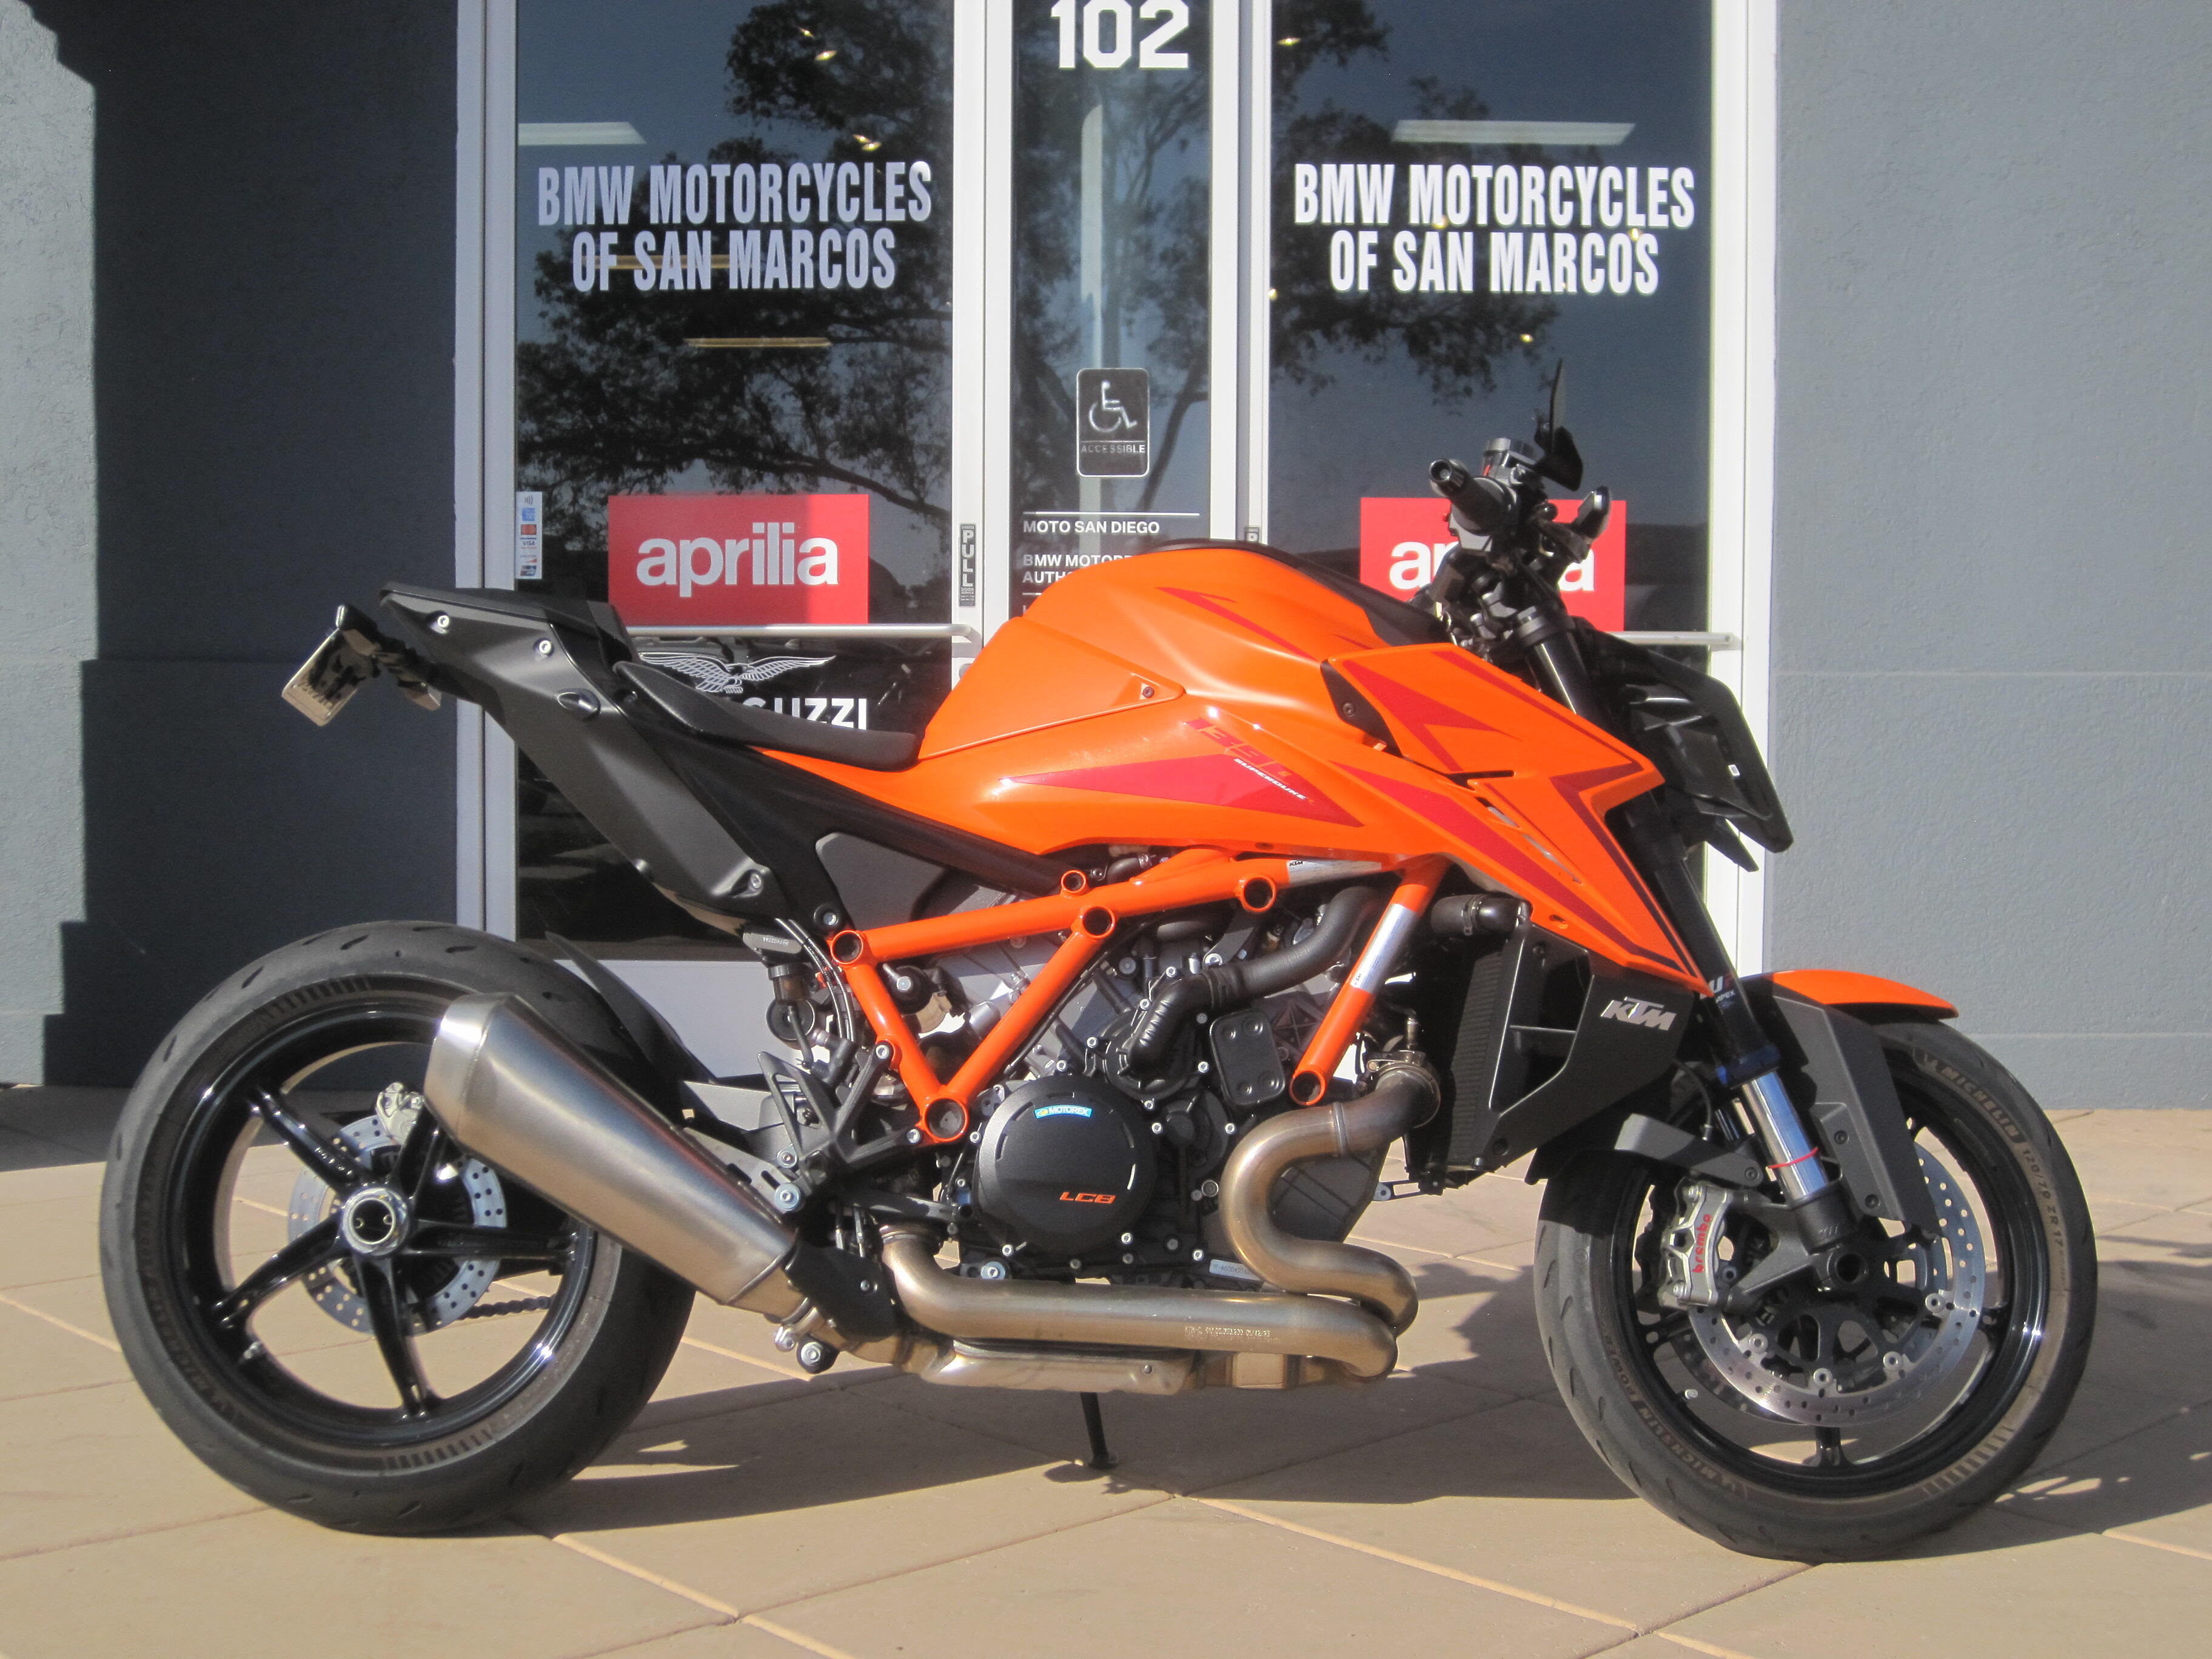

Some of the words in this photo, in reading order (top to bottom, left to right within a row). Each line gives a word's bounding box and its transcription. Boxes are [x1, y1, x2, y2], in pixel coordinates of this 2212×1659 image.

[1051, 0, 1188, 68] 102
[538, 166, 634, 226] BMW
[649, 161, 932, 224] MOTORCYCLES
[1295, 163, 1395, 224] BMW
[1409, 164, 1695, 229] MOTORCYCLES
[572, 232, 618, 292] OF
[634, 230, 711, 291] SAN
[729, 228, 896, 290] MARCOS
[1330, 230, 1378, 292] OF
[1393, 230, 1473, 293] SAN
[1490, 232, 1658, 295] MARCOS
[1081, 443, 1145, 454] ACCESSIBLE
[962, 529, 974, 584] PULL
[1023, 520, 1071, 532] MOTO
[1074, 521, 1107, 533] SAN
[1111, 521, 1159, 534] DIEGO
[637, 522, 838, 597] aprilia
[1023, 555, 1062, 566] BMW
[1601, 996, 1677, 1031] KTM
[1048, 1105, 1089, 1115] MOTOREX
[1940, 1065, 2020, 1138] MICHELIN
[1059, 1191, 1116, 1204] LC8
[1692, 1213, 1712, 1273] brembo
